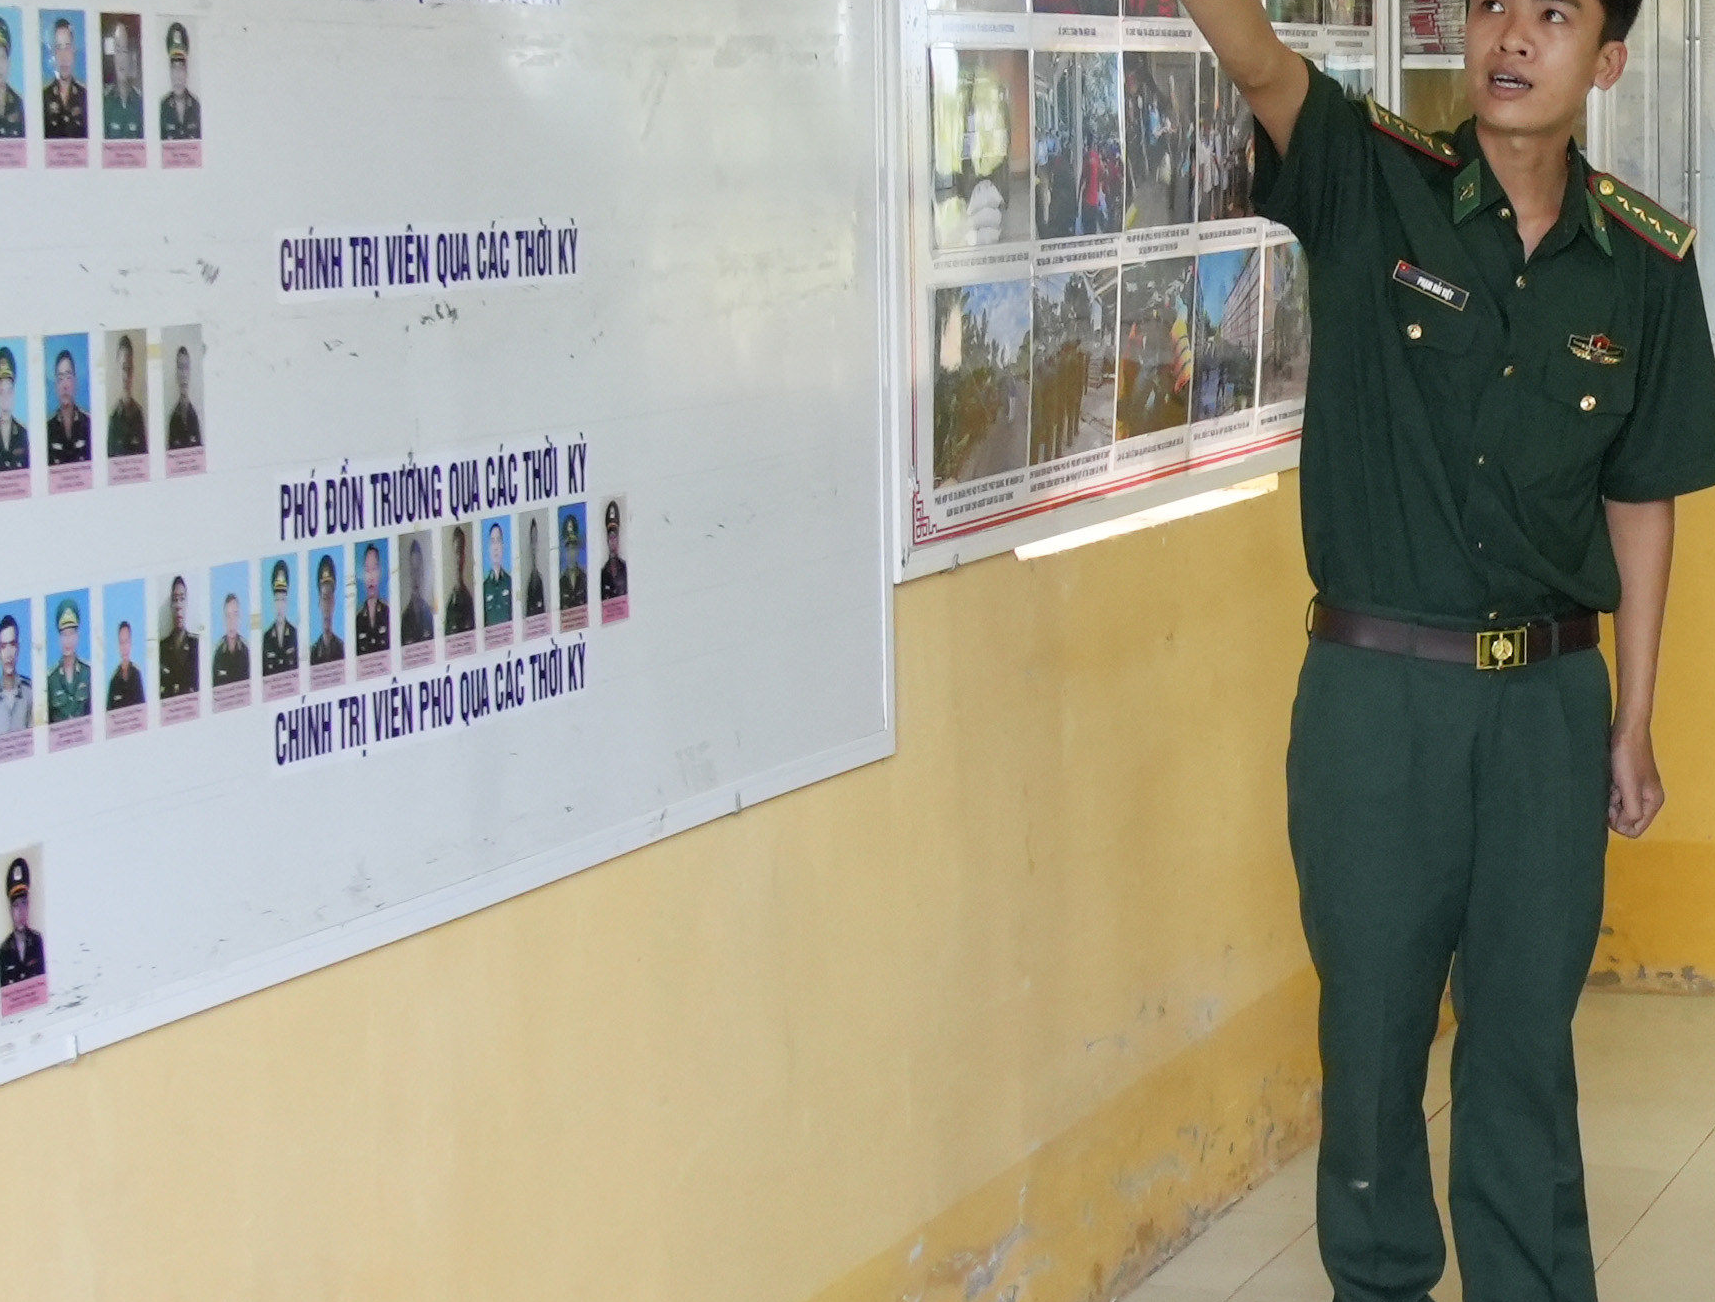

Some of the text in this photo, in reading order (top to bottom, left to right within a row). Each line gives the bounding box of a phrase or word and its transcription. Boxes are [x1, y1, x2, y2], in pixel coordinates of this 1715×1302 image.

[280, 217, 578, 298] CHÍNH TRỊ VIÊN QUA CÁC THỜI KỲ
[280, 468, 319, 541] PHÓ
[325, 458, 365, 535] ĐỒN
[370, 448, 443, 528] TRƯỞNG
[448, 459, 481, 521] QUA
[485, 443, 518, 510] CÁC
[523, 434, 559, 503] THỜI
[567, 434, 588, 495] KỲ
[275, 632, 587, 766] CHÍNH TRỊ VIÊN PHÓ QUA CÁC THỜI KỲ
